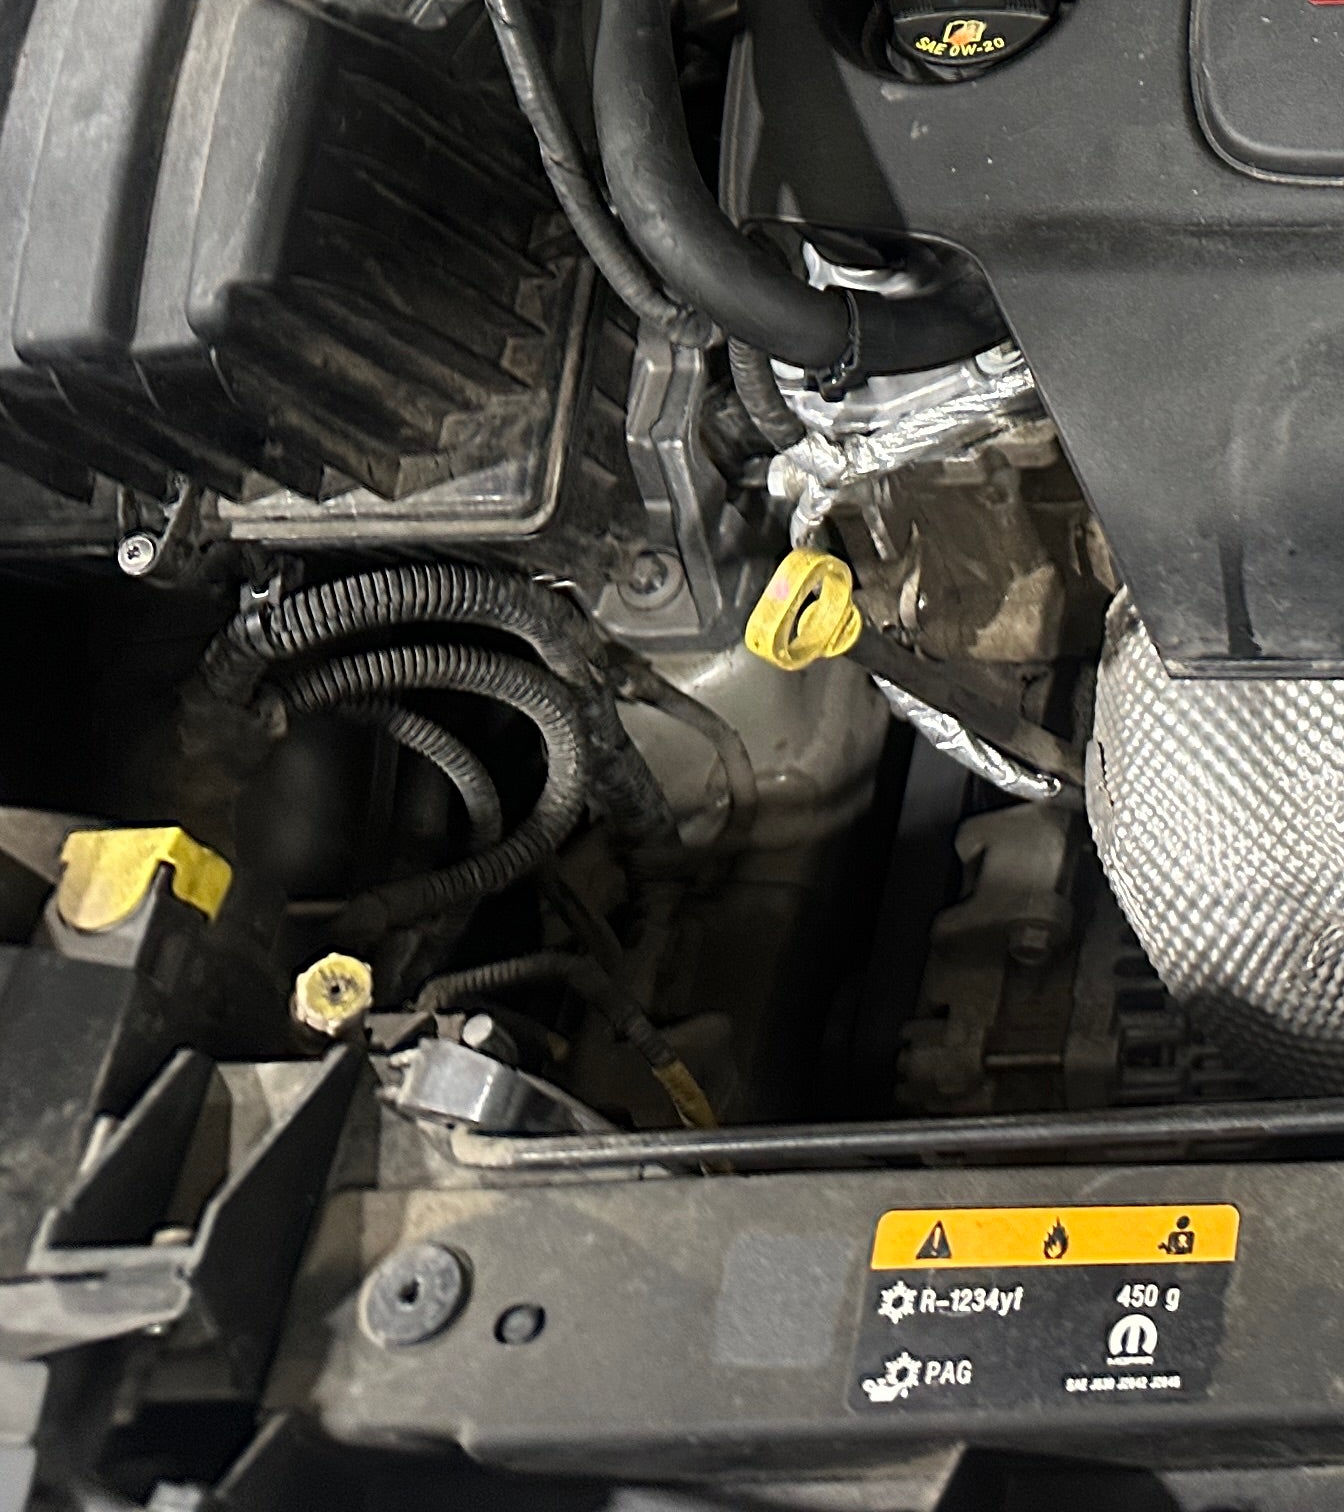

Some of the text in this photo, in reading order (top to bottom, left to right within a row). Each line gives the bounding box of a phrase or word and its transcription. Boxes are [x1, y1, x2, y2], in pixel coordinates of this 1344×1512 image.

[916, 37, 1005, 57] SAE 0W-20
[919, 1284, 1181, 1316] R-1234yf 450 g
[924, 1360, 972, 1386] PAG
